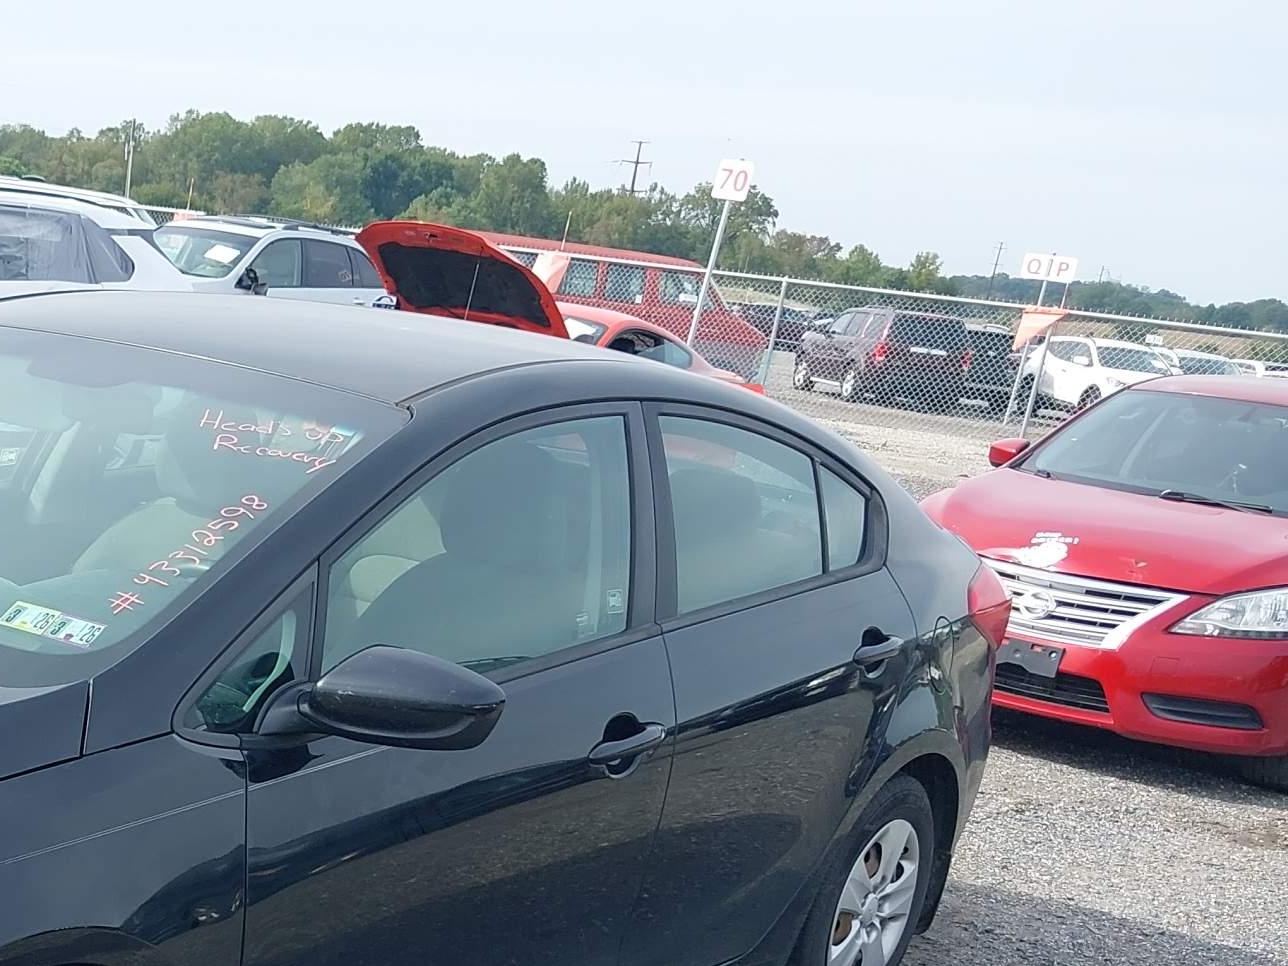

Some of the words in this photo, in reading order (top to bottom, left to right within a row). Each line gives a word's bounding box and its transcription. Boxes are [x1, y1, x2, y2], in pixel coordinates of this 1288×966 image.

[720, 168, 748, 192] 70
[1027, 258, 1042, 275] Q
[1056, 261, 1070, 277] P
[50, 621, 67, 636] 3
